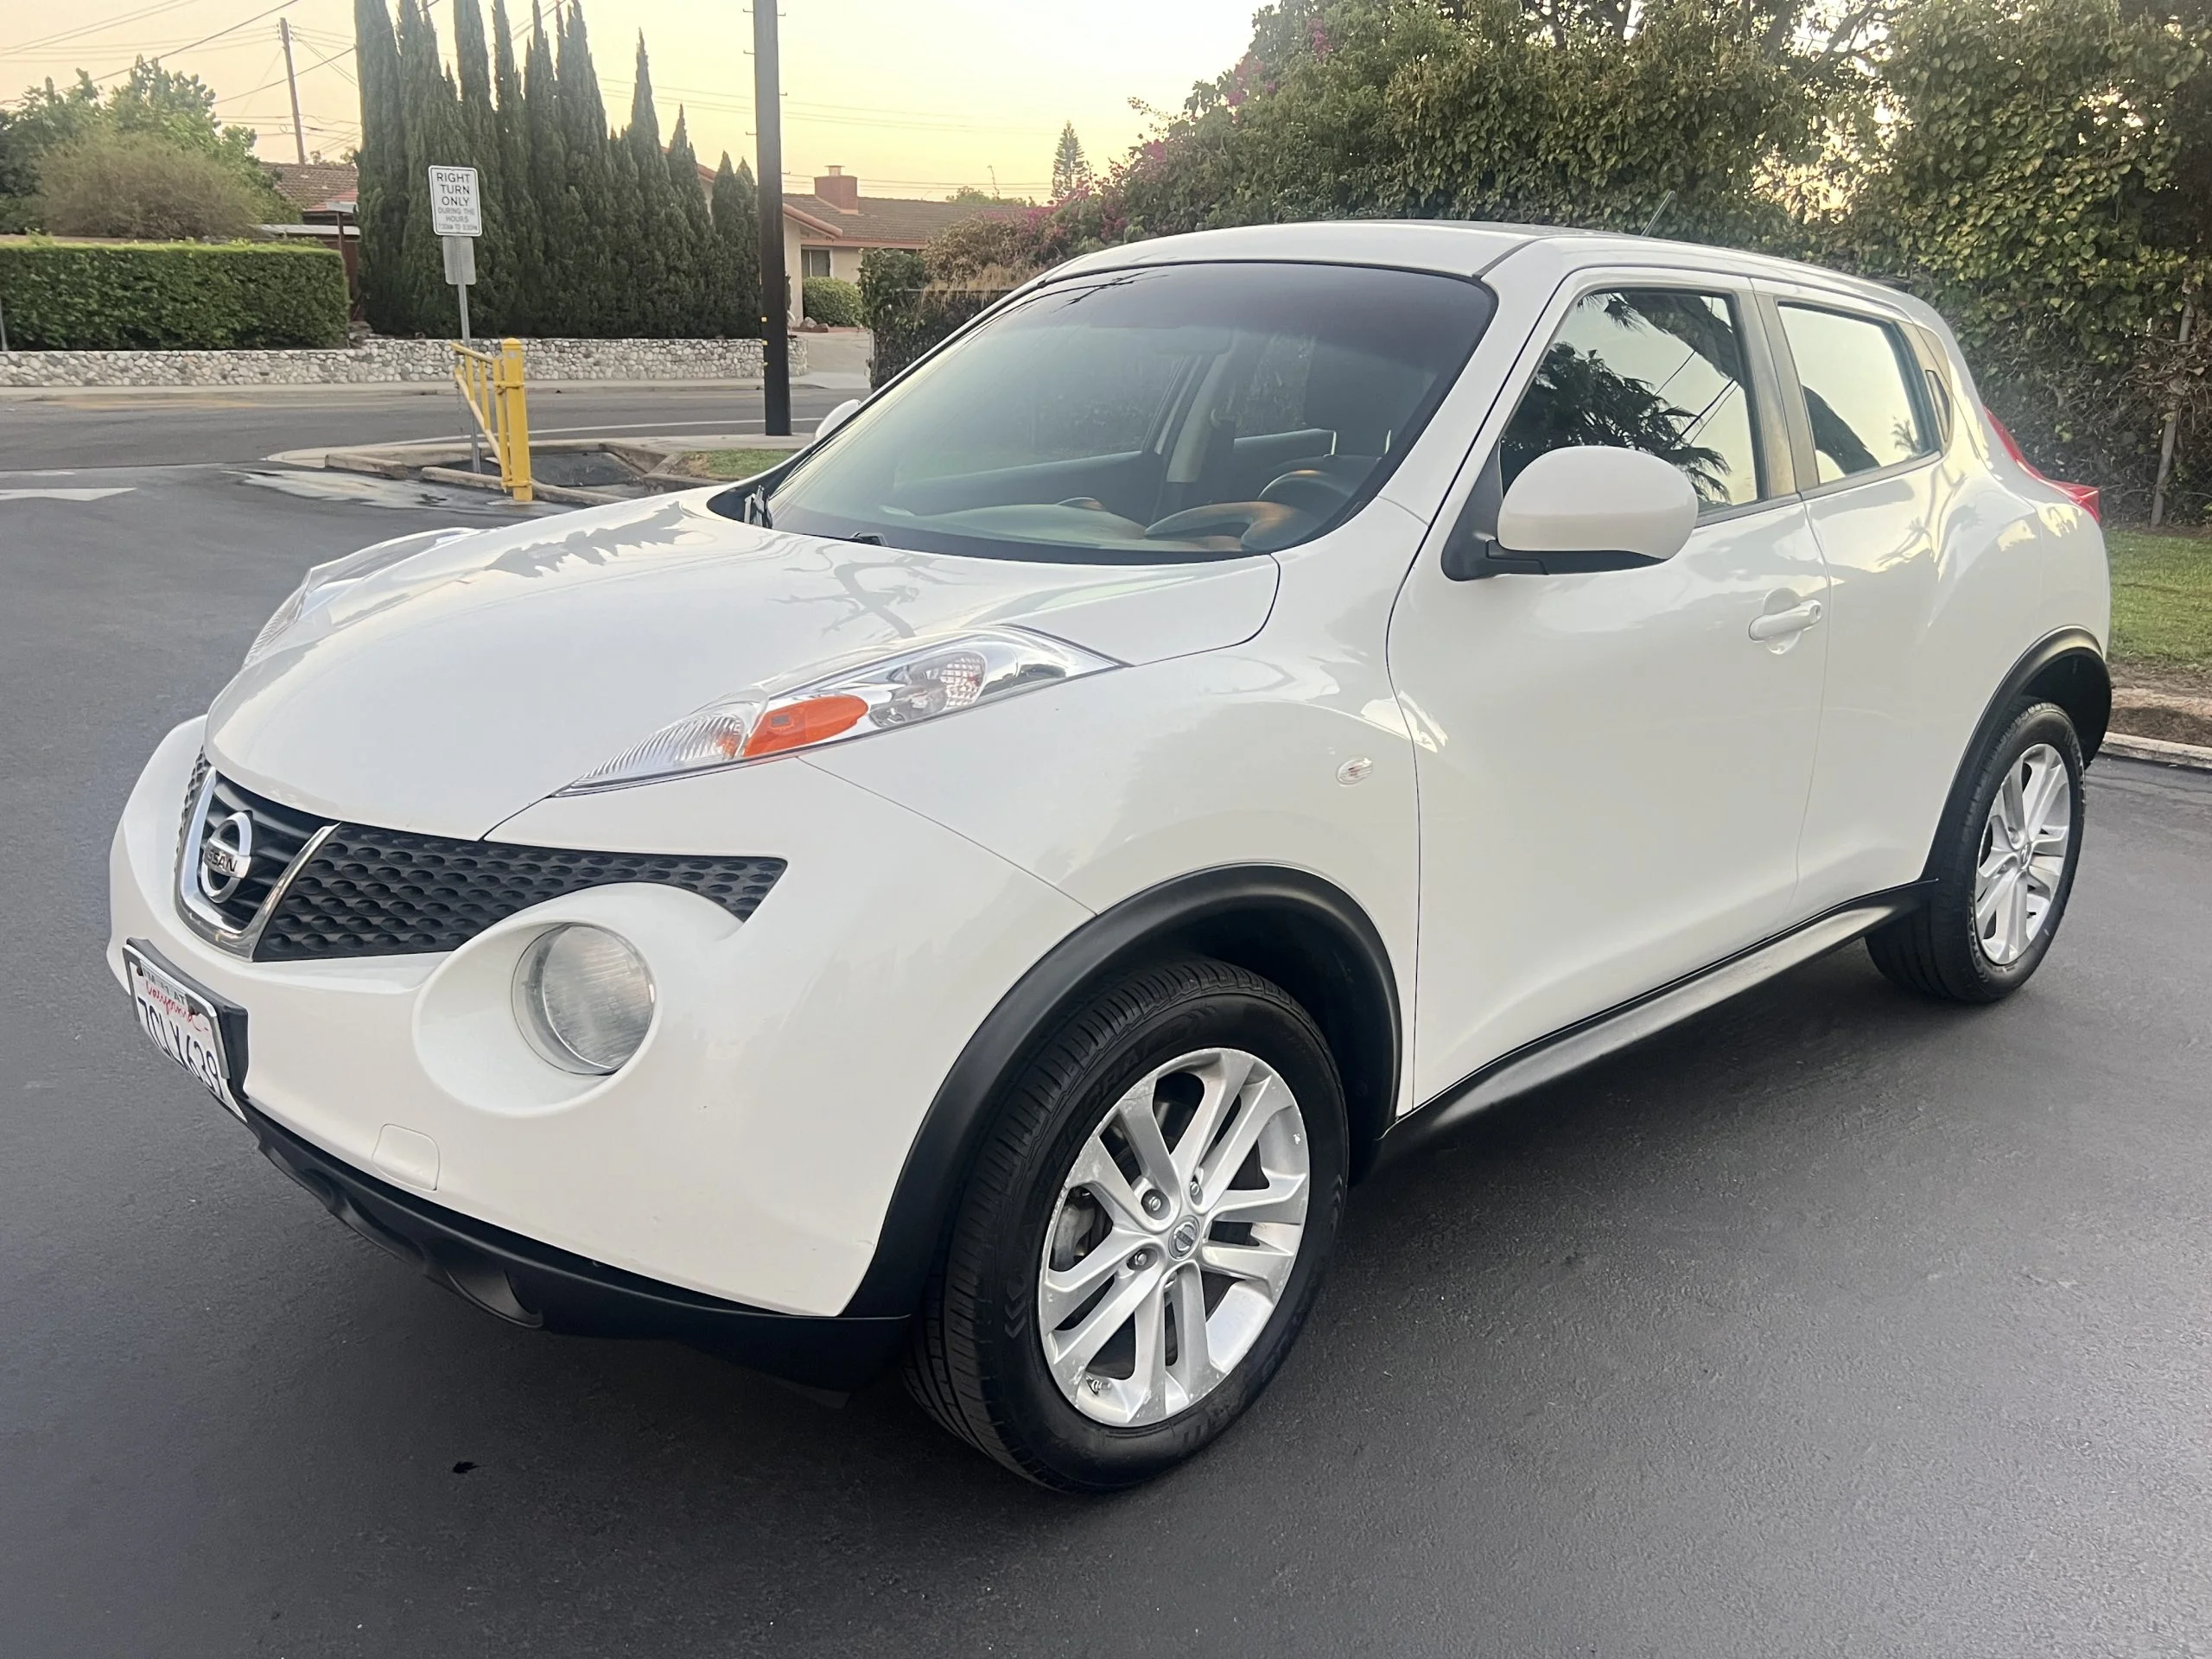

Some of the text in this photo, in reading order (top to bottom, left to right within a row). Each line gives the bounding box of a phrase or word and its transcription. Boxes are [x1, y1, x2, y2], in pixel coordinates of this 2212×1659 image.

[436, 172, 471, 183] RIGHT
[440, 184, 470, 194] TURN
[442, 196, 469, 207] ONLY
[437, 207, 461, 215] DURING
[203, 850, 238, 872] SSAN
[137, 997, 225, 1100] 7CLY639
